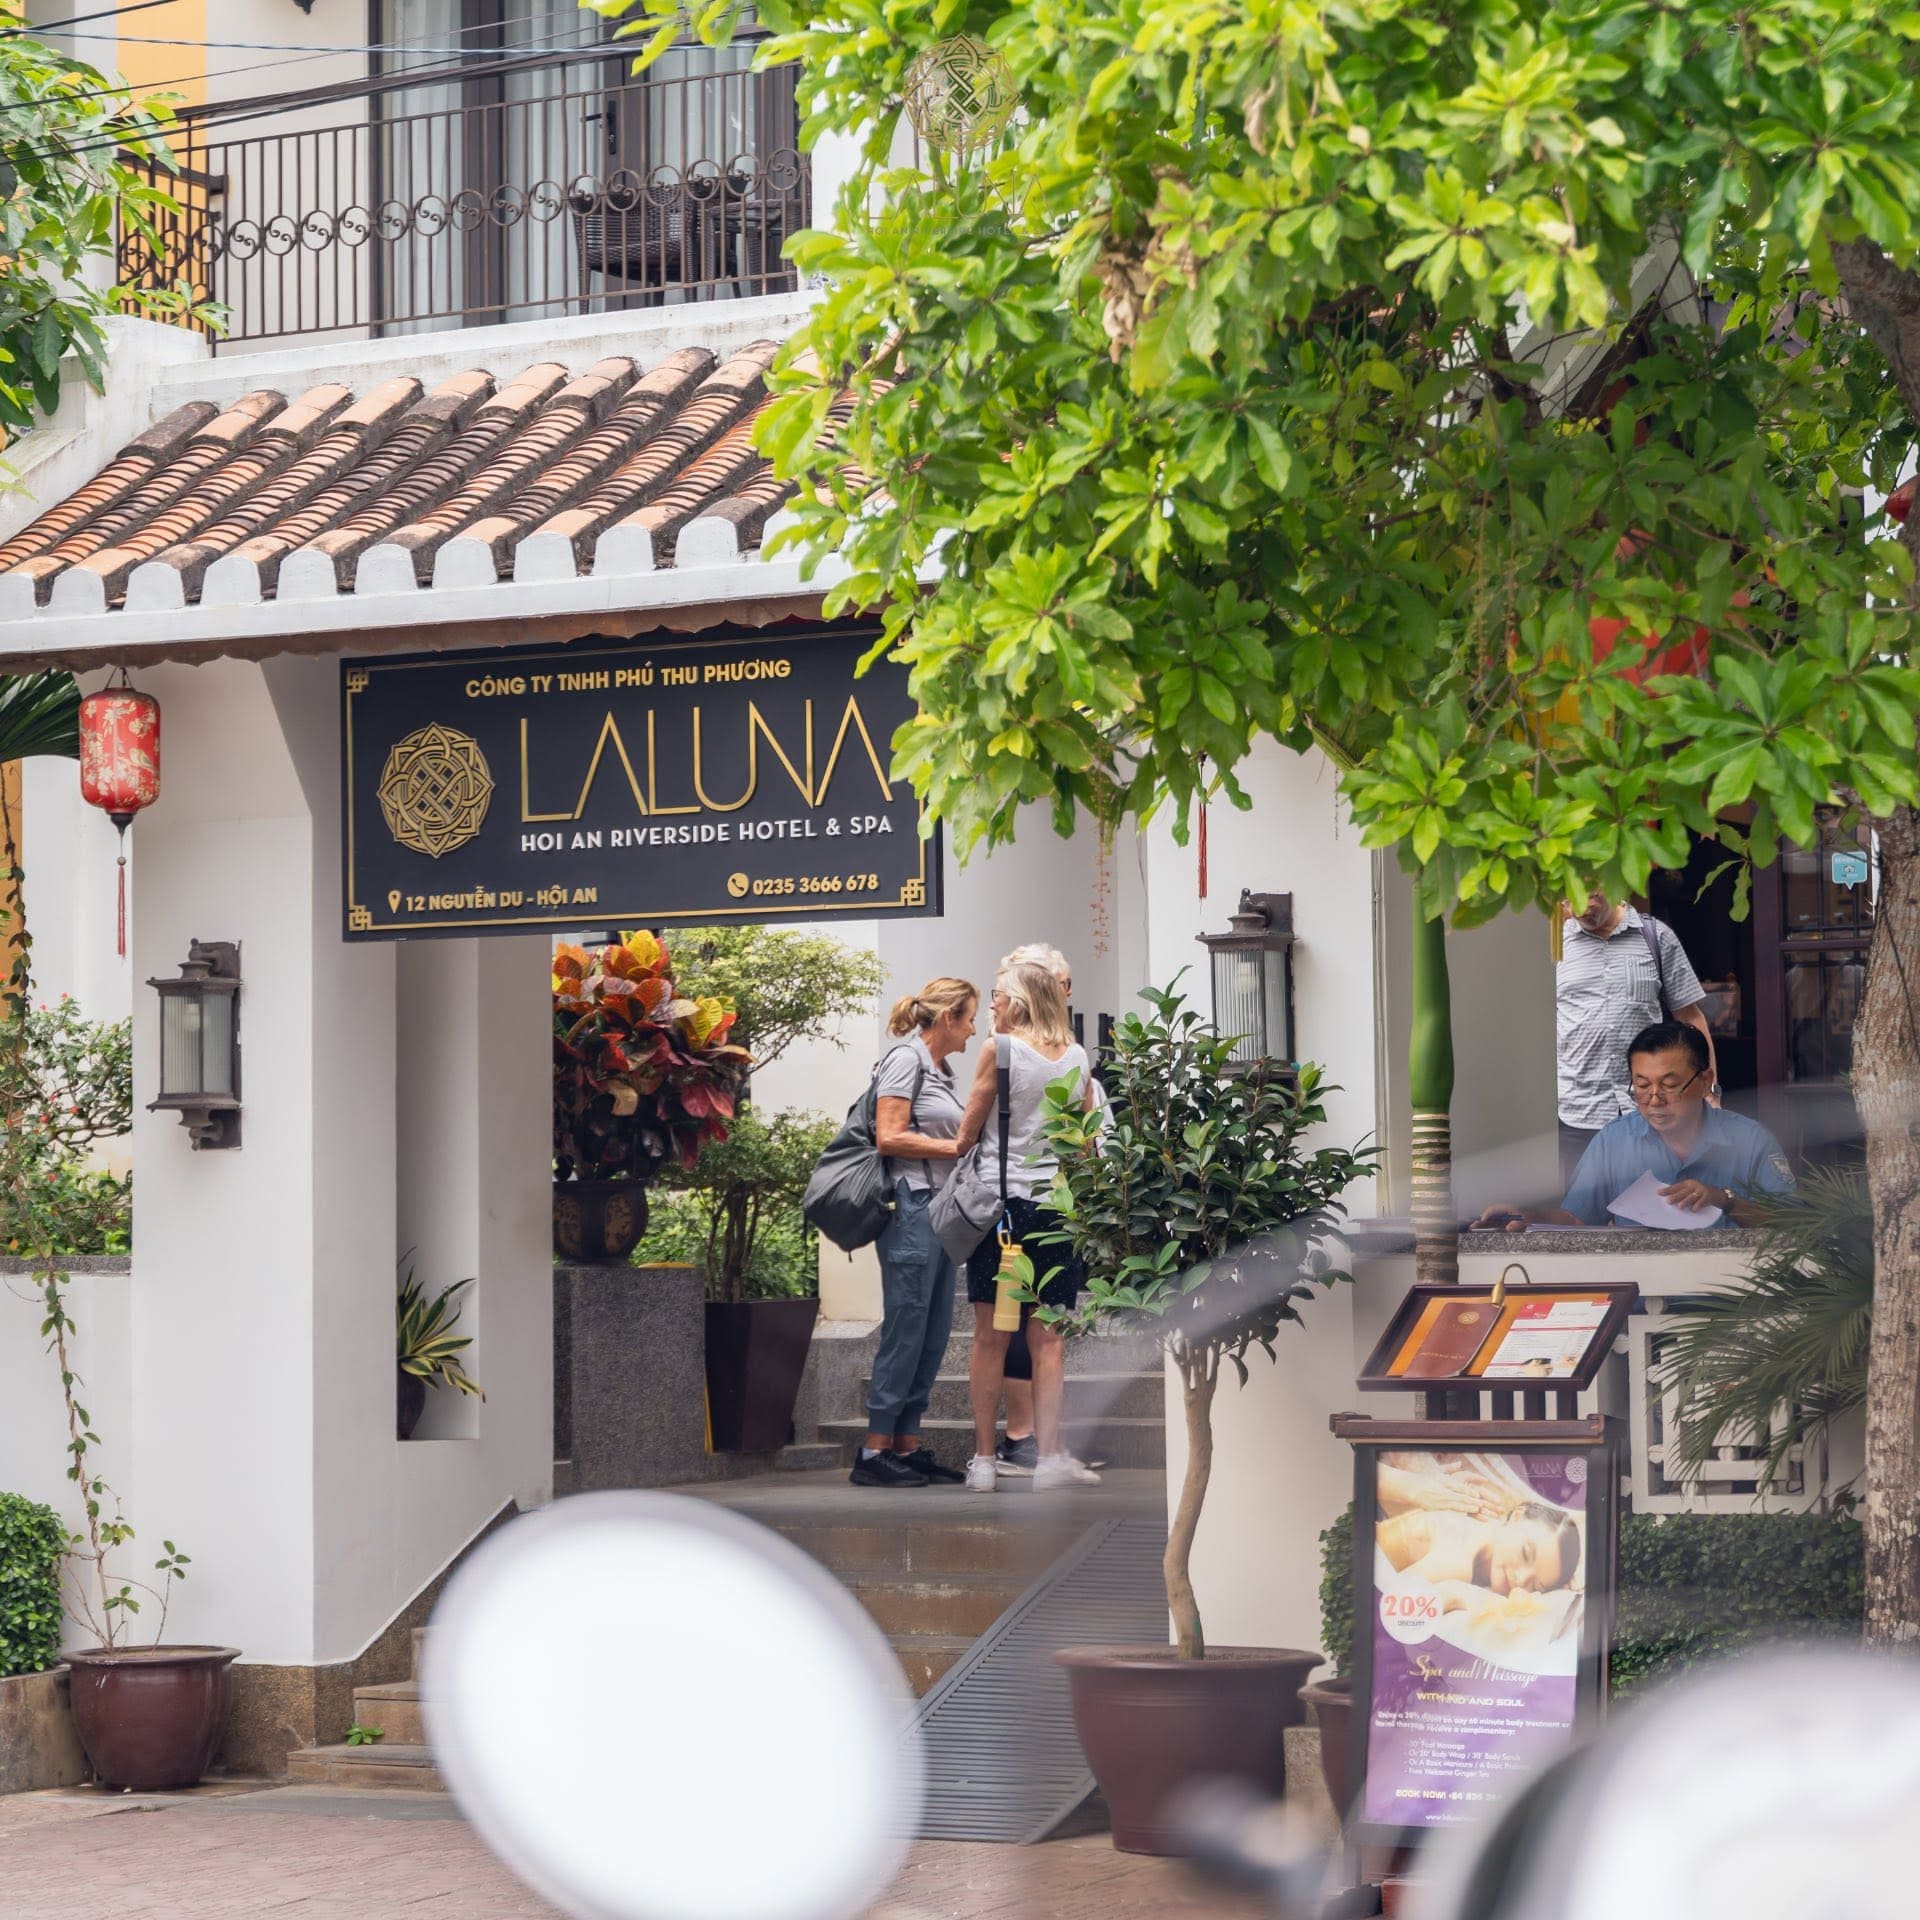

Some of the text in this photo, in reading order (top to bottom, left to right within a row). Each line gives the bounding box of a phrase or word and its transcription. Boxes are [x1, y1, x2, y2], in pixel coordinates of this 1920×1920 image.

[465, 659, 791, 698] CÔNG TY TNHH PHÚ THU PHƯƠNG
[520, 694, 894, 823] LALUNA
[520, 815, 894, 852] HOI AN RIVERSIDE HOTEL & SPA
[406, 896, 425, 912] 12
[429, 885, 496, 911] NGUYỄN
[500, 891, 523, 908] DU
[537, 884, 568, 910] HỘI
[572, 887, 598, 904] AN
[752, 873, 879, 896] 0235 3666 678
[1384, 1594, 1439, 1618] 20%
[1409, 1655, 1443, 1682] Spa
[1468, 1696, 1494, 1706] AND
[1496, 1698, 1525, 1707] SOUL
[1395, 1788, 1421, 1798] BOOK
[1422, 1790, 1447, 1800] NOW!
